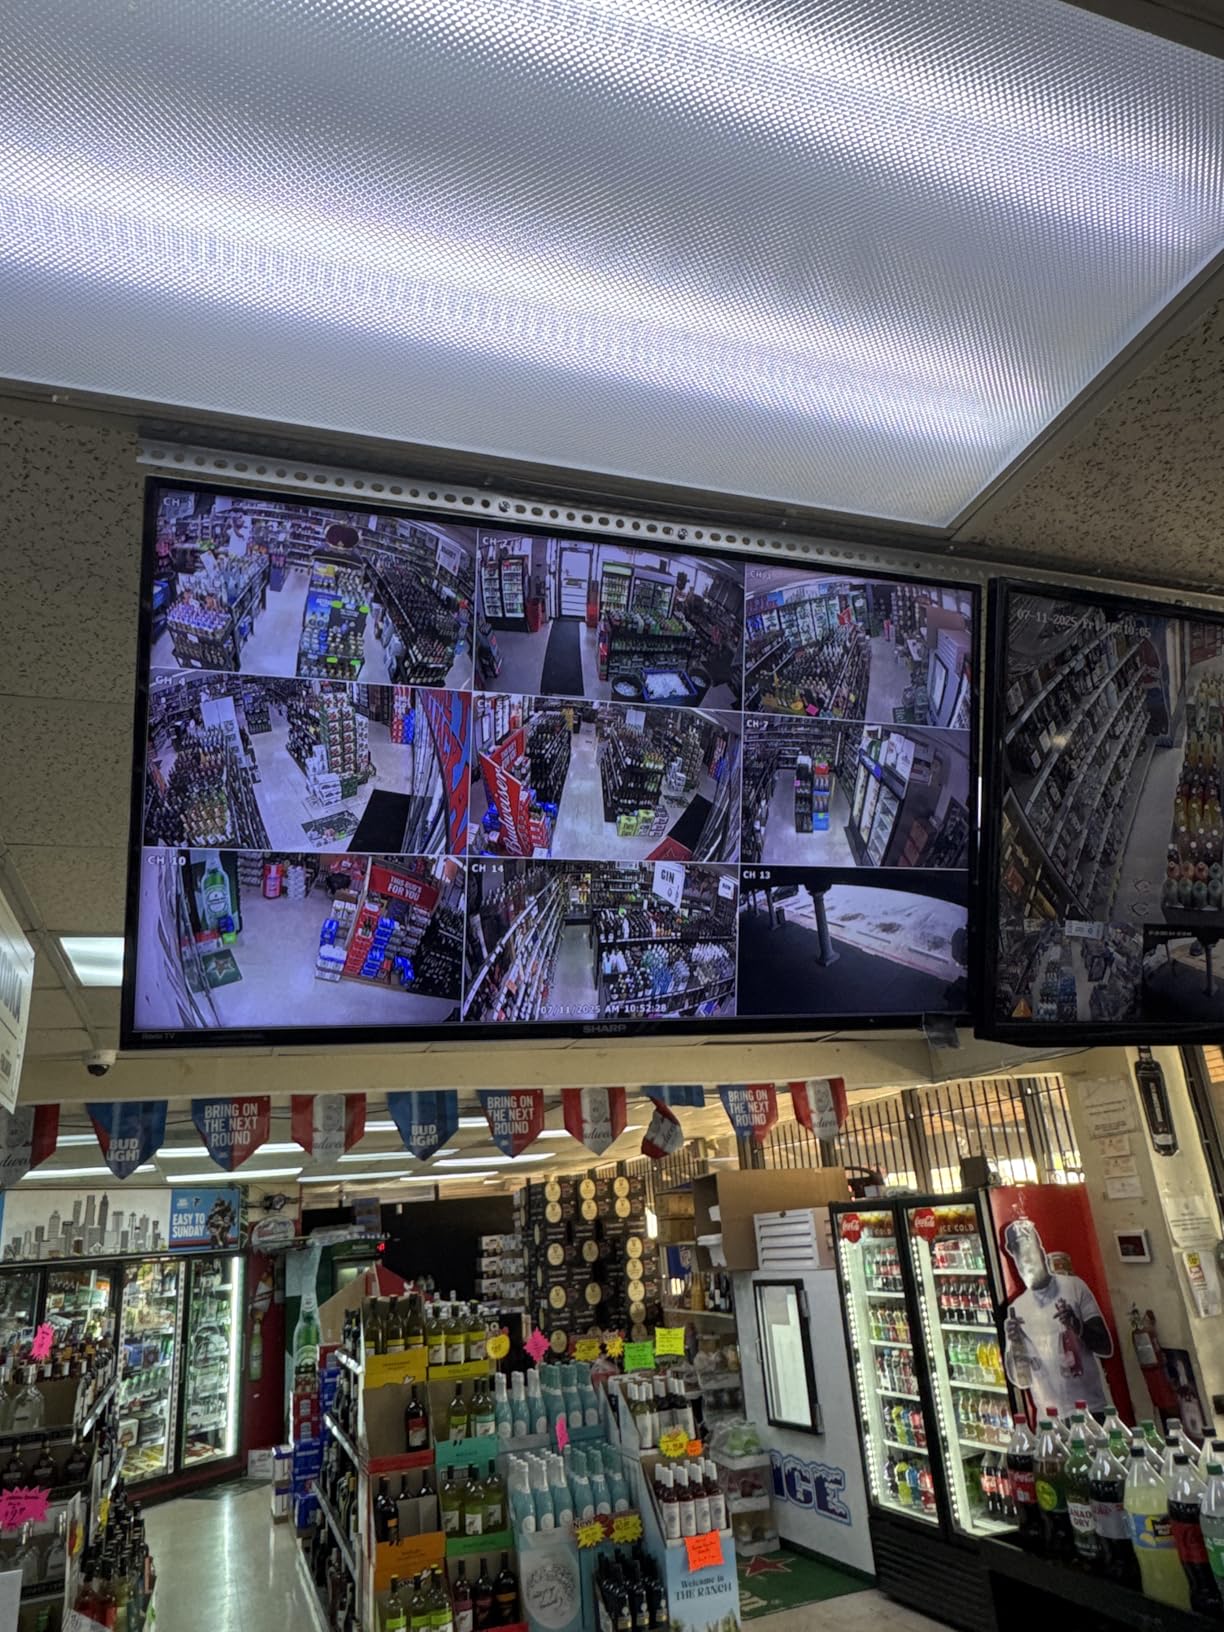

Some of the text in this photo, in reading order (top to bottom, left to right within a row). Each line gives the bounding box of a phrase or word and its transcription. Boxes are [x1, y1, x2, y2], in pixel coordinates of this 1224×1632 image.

[482, 537, 497, 546] CH
[746, 719, 769, 730] CH 7
[147, 855, 187, 866] CH 10
[471, 863, 504, 873] CH 14
[743, 870, 771, 879] CH 13
[660, 869, 675, 885] GIN
[387, 882, 420, 902] FOR YOU
[604, 1005, 619, 1014] AM
[623, 1003, 668, 1013] 10:52:28
[582, 1023, 627, 1034] SHARP
[727, 1089, 769, 1101] BRING ON
[487, 1095, 534, 1109] BRING ON
[729, 1101, 770, 1114] THE NEXT
[203, 1102, 259, 1119] BRING ON
[487, 1107, 534, 1121] THE NEXT
[203, 1116, 259, 1132] THE NEXT
[735, 1113, 768, 1127] ROUND
[411, 1124, 438, 1135] BUD
[494, 1121, 530, 1135] ROUND
[109, 1138, 139, 1150] BUD
[210, 1131, 251, 1148] ROUND
[172, 1213, 206, 1226] EASY TO
[172, 1225, 206, 1239] SUNDAY
[954, 1223, 976, 1233] COLD
[769, 1448, 852, 1527] ICE
[1073, 1518, 1091, 1528] DRY
[680, 1576, 715, 1590] Welcome
[675, 1583, 733, 1602] THE RANCH
